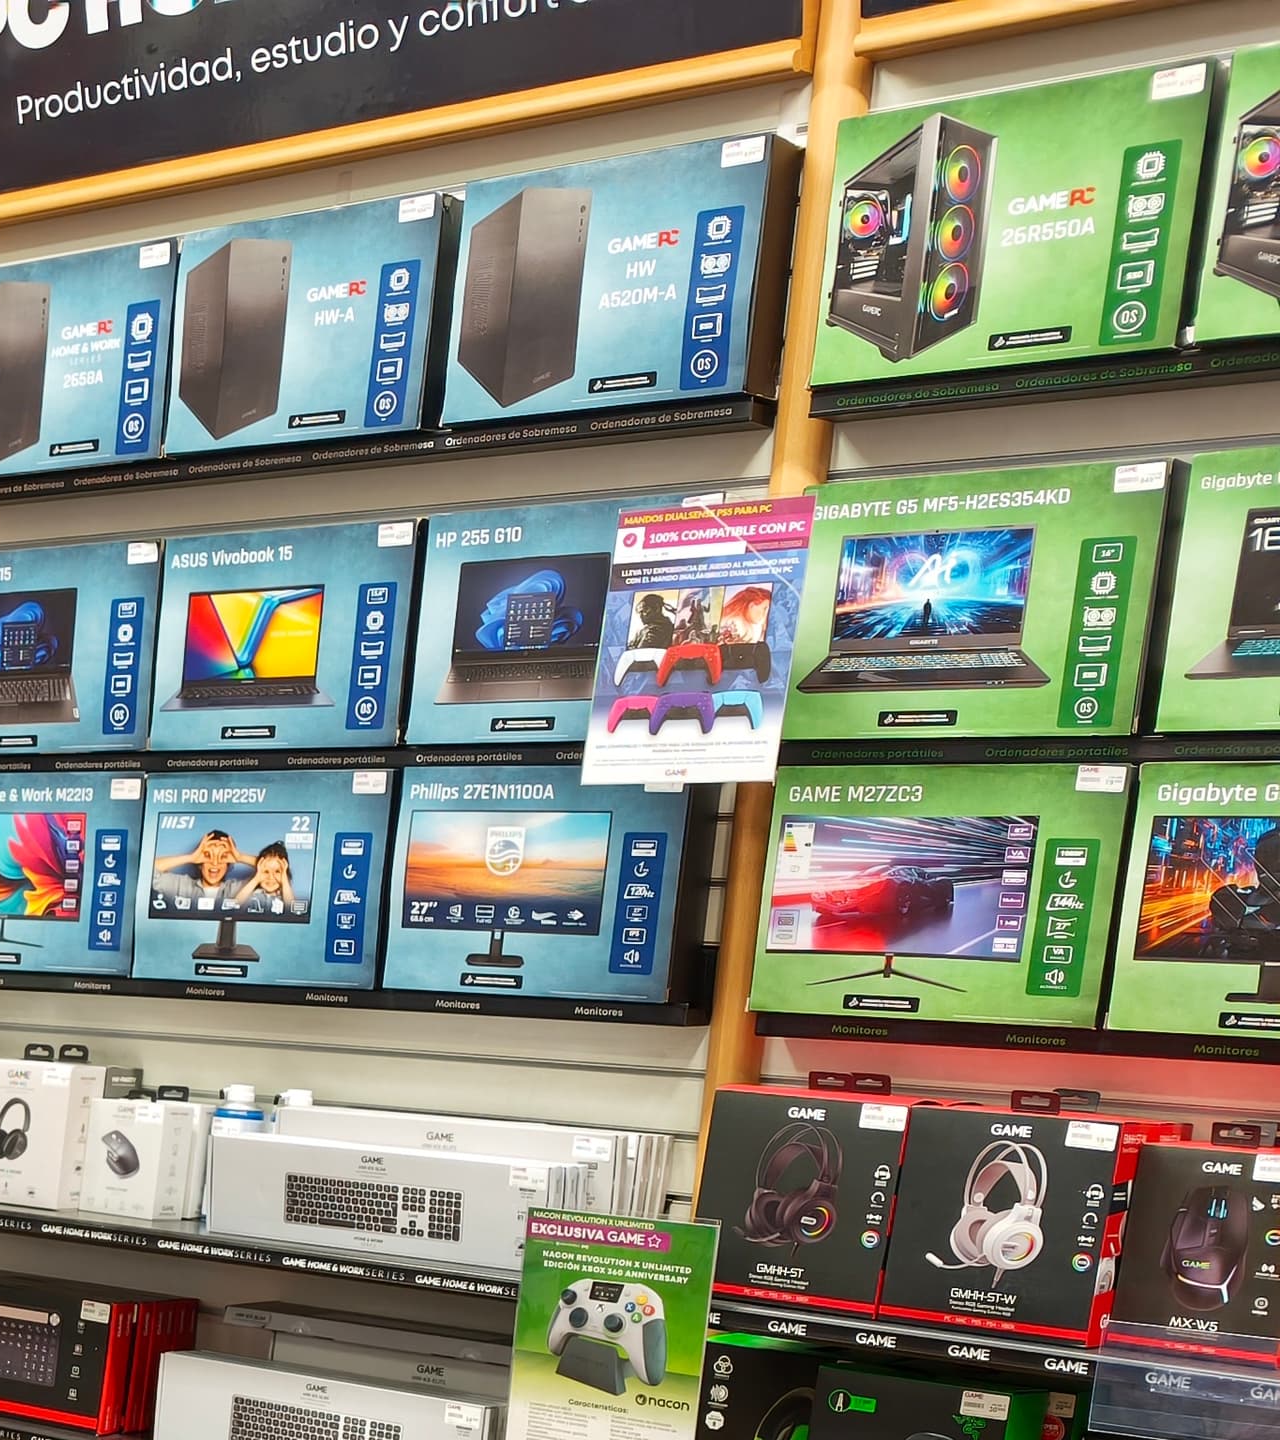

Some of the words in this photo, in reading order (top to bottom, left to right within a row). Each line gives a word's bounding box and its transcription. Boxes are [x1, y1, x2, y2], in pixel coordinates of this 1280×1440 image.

[15, 48, 242, 125] Productividad,
[250, 21, 380, 75] estudio
[387, 17, 410, 54] y
[1000, 218, 1096, 248] 26R550A
[626, 258, 656, 279] HW
[599, 284, 678, 311] A520M-A
[314, 309, 355, 327] HW-A
[590, 416, 653, 431] Ordenadores
[656, 412, 669, 425] de
[673, 406, 732, 422] Sobremesa
[1200, 473, 1271, 490] Gigabyte
[624, 513, 662, 525] MANDOS
[665, 509, 714, 521] DUALSENSE
[732, 506, 757, 515] PARA
[760, 504, 772, 513] PC
[814, 496, 890, 521] GIGABYTE
[896, 494, 919, 515] G5
[436, 531, 455, 548] HP
[461, 528, 486, 546] 255
[491, 526, 522, 544] G10
[649, 531, 679, 544] 100%
[680, 525, 756, 540] COMPATIBLE
[758, 523, 786, 534] CON
[788, 521, 806, 532] PC
[171, 551, 207, 569] ASUS
[211, 546, 272, 565] Vivobook
[277, 545, 292, 561] 15
[4, 788, 14, 802] &
[19, 788, 52, 802] Work
[153, 790, 178, 804] MSI
[183, 789, 209, 804] PRO
[213, 788, 266, 804] MP225V
[410, 784, 459, 802] Philips
[789, 785, 841, 804] GAME
[847, 784, 923, 803] M27ZC3
[291, 816, 310, 831] 22
[574, 1005, 623, 1017] Monitores
[788, 1106, 826, 1122] GAME
[531, 1223, 605, 1241] EXCLUSIVA
[607, 1231, 645, 1245] GAME
[543, 1251, 574, 1261] NACON
[576, 1253, 632, 1267] REVOLUTION
[642, 1262, 691, 1274] UNLIMITED
[544, 1260, 580, 1271] EDICIÓN
[582, 1266, 605, 1275] XBOX
[608, 1268, 623, 1276] 360
[625, 1270, 688, 1284] ANNIVERSARY
[950, 1286, 1017, 1306] GMHH-ST-W
[1169, 1316, 1219, 1332] MX-W5
[648, 1397, 690, 1411] nacon
